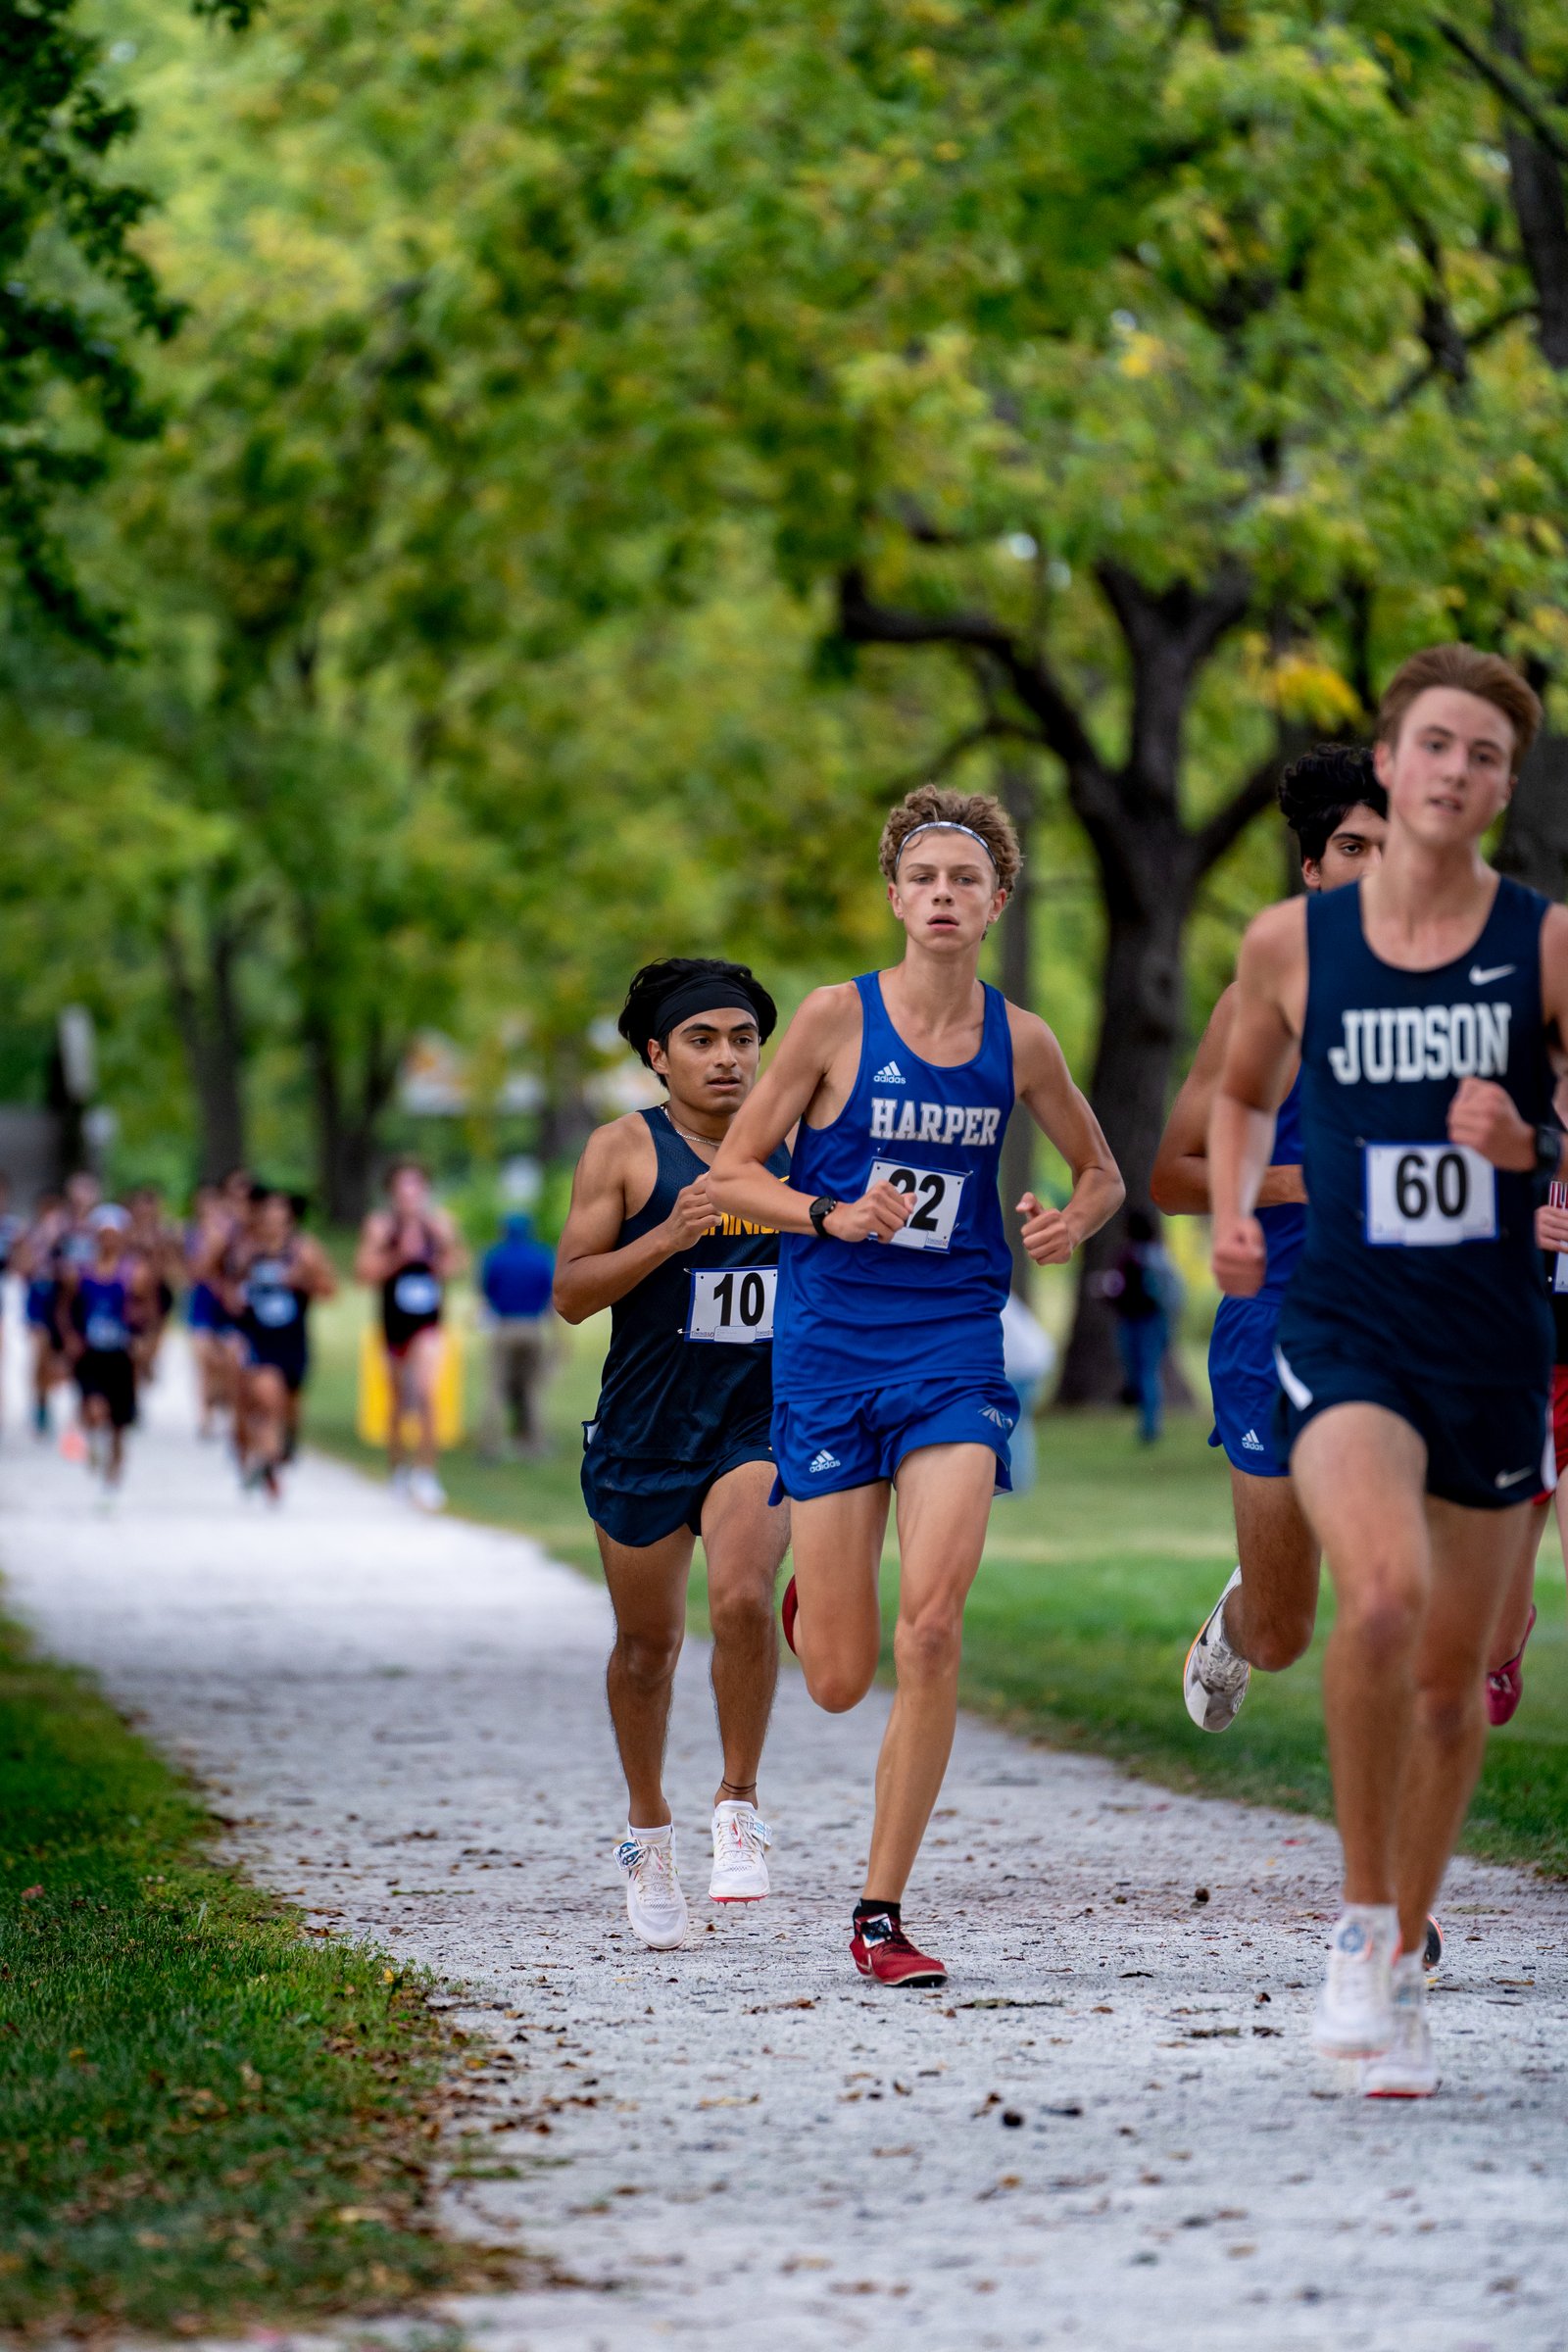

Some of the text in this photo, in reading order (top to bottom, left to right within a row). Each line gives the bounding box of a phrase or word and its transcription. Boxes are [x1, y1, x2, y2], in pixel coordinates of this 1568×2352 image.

[1327, 1002, 1512, 1085] JUDSON
[873, 1074, 906, 1085] adidas
[869, 1097, 1002, 1147] HARPER
[1396, 1152, 1468, 1220] 60
[713, 1272, 765, 1327] 10
[808, 1459, 842, 1473] adidas
